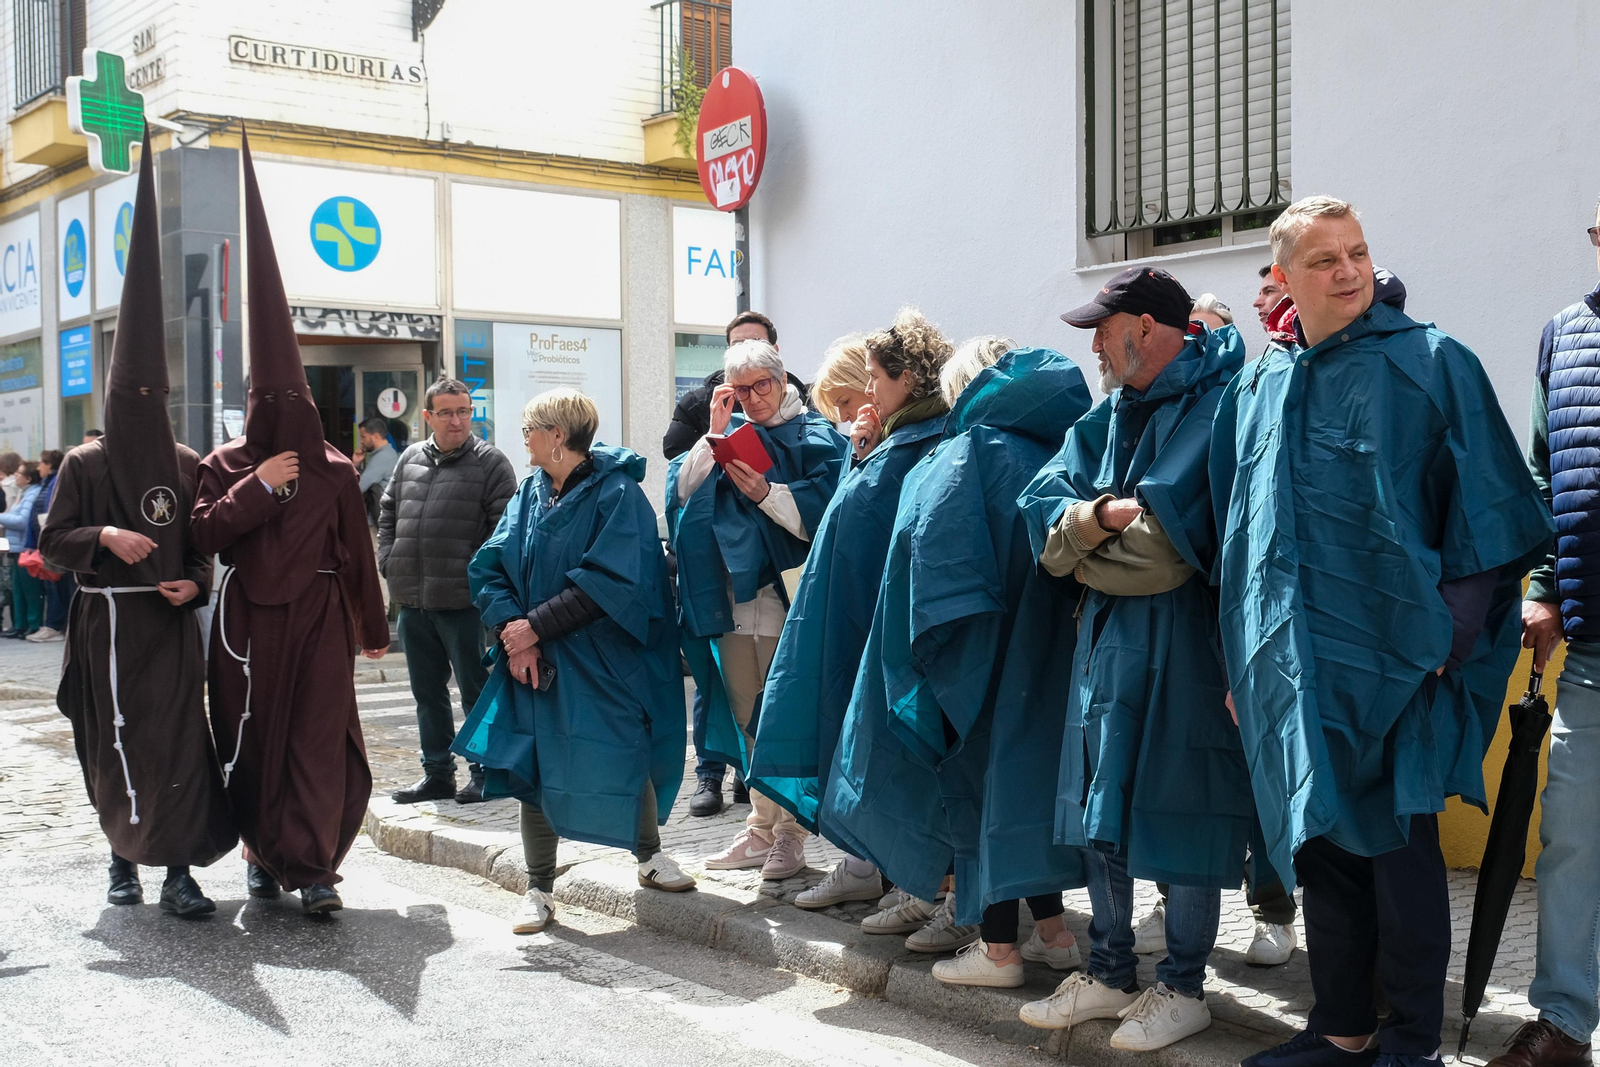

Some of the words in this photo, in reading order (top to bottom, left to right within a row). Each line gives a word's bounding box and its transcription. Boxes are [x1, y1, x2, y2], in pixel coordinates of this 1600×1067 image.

[133, 26, 154, 53] SAN
[126, 57, 163, 90] CENTE
[233, 40, 421, 83] CURTIDURIAS
[0, 238, 37, 295] CIA
[530, 332, 588, 352] ProFaes4
[463, 332, 488, 441] ENTE
